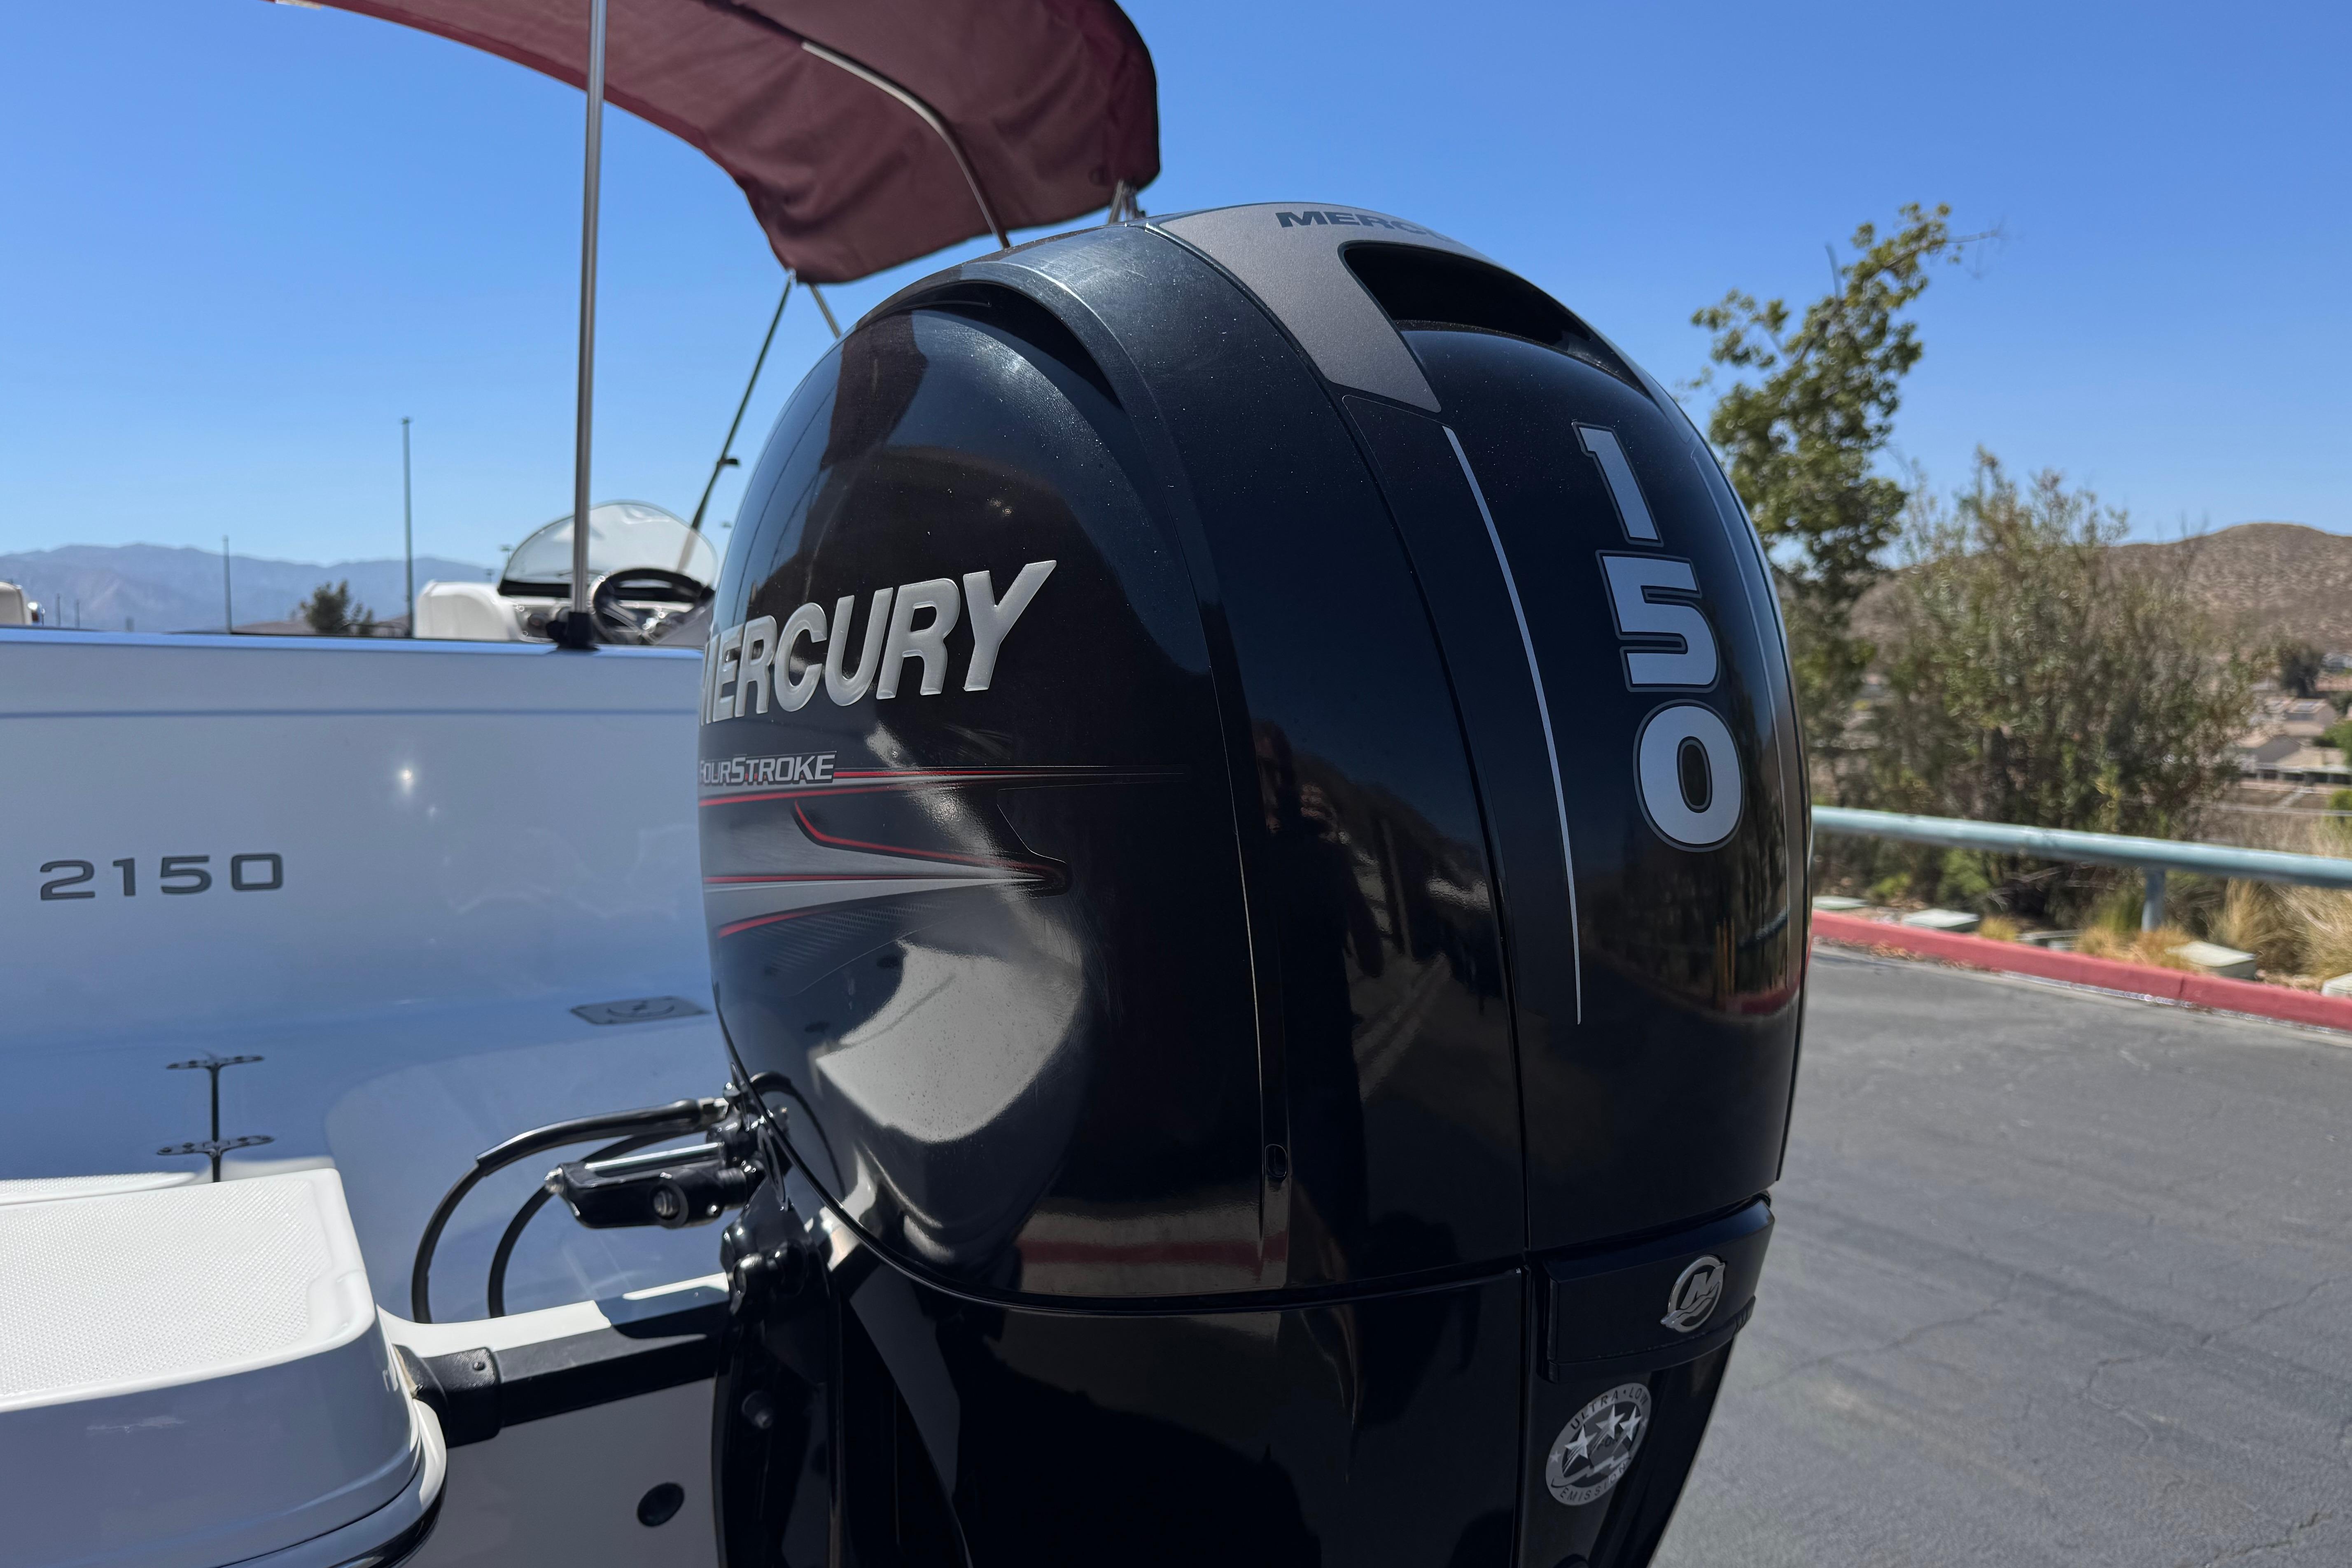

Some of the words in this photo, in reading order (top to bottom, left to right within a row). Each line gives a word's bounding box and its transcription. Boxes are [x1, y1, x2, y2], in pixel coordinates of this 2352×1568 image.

[1572, 422, 1745, 852] 150
[40, 852, 284, 901] 2150
[1570, 1389, 1619, 1430] ULTRA
